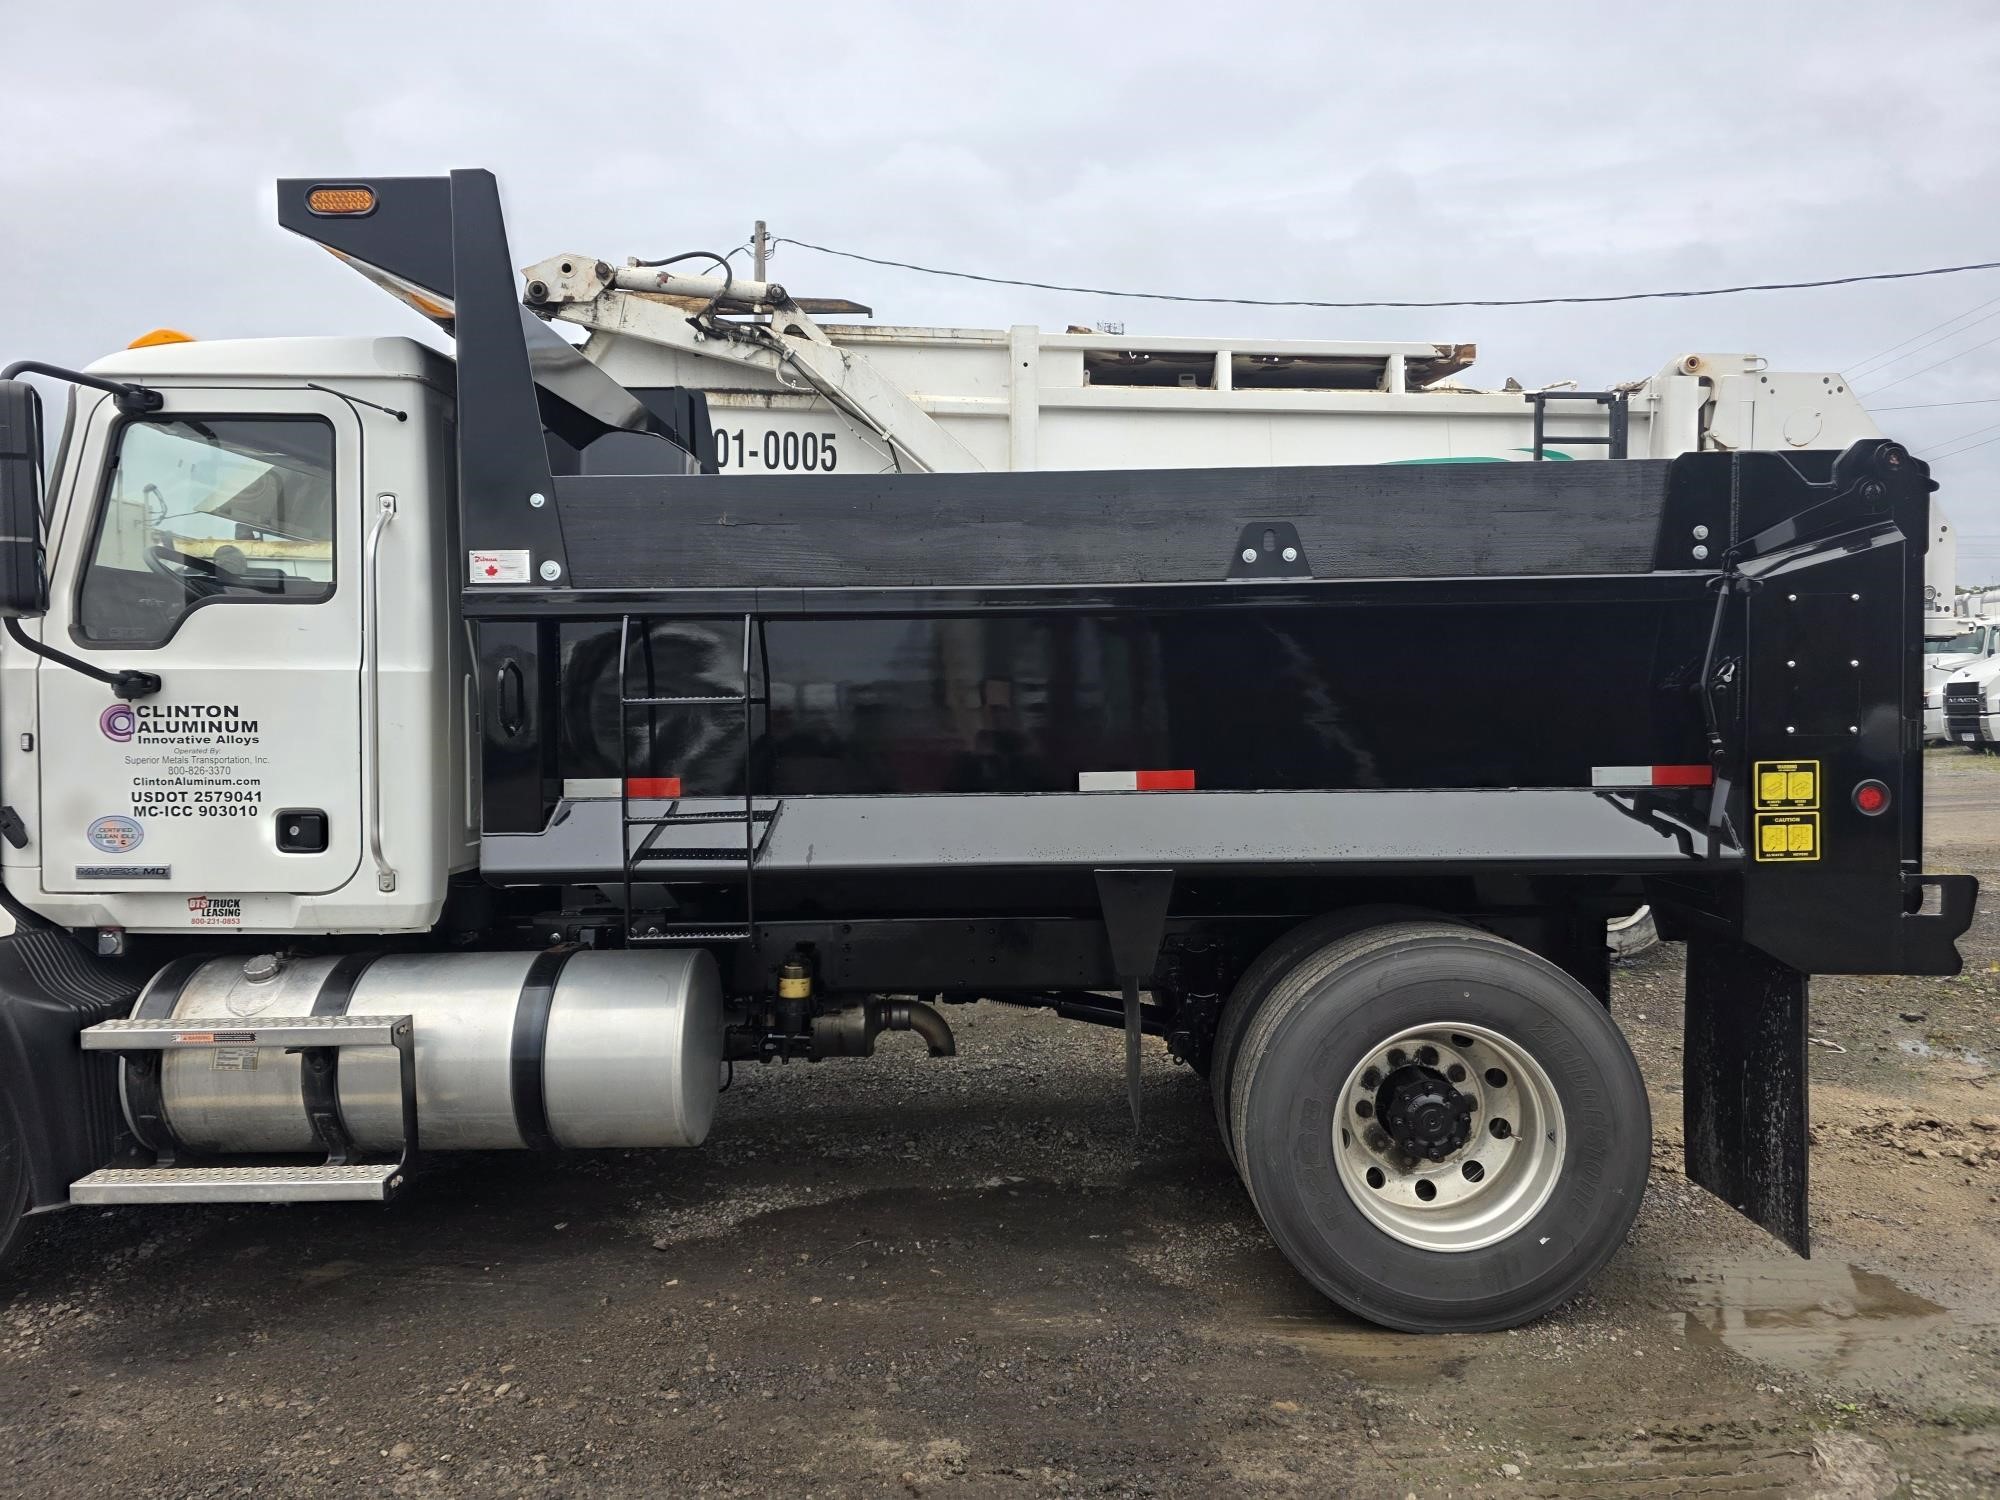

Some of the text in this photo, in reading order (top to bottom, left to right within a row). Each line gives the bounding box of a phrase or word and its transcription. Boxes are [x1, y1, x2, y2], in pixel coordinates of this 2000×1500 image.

[136, 705, 239, 718] CLINTON
[137, 720, 258, 734] ALUMINUM
[138, 735, 260, 746] Innovative Alloys
[124, 755, 270, 765] Superior Metals Transportation, Inc.
[168, 766, 231, 775] 800-826-3370
[133, 777, 261, 786] ClintonAluminum.com
[131, 791, 263, 803] USDOT 2579041
[133, 805, 258, 817] MC-ICC 903010
[77, 867, 139, 876] MACK
[207, 899, 241, 908] TRUCK
[201, 908, 241, 917] LEASING
